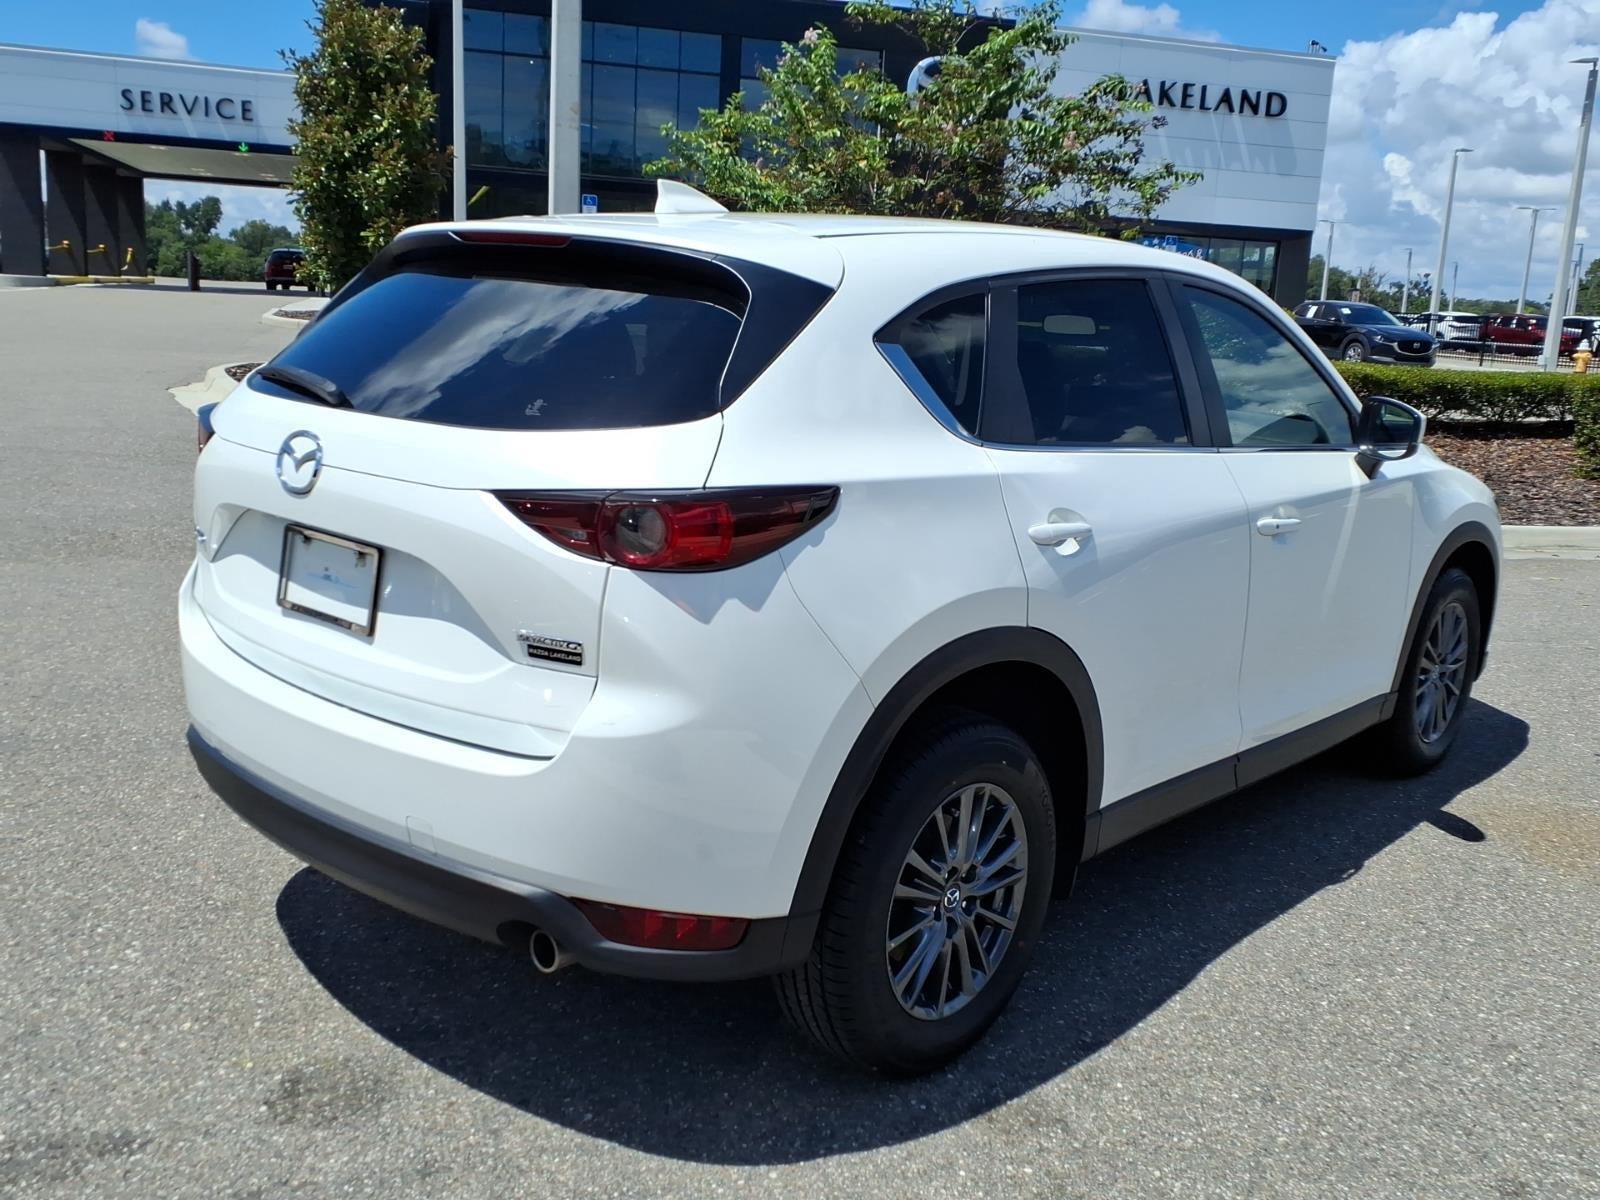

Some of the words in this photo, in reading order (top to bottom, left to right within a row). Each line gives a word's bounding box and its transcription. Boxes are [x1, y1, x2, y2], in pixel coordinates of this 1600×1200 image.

[119, 88, 254, 122] SERVICE
[1133, 78, 1288, 118] AKELAND
[528, 648, 549, 656] MAZDA
[549, 651, 581, 662] LAKELAND
